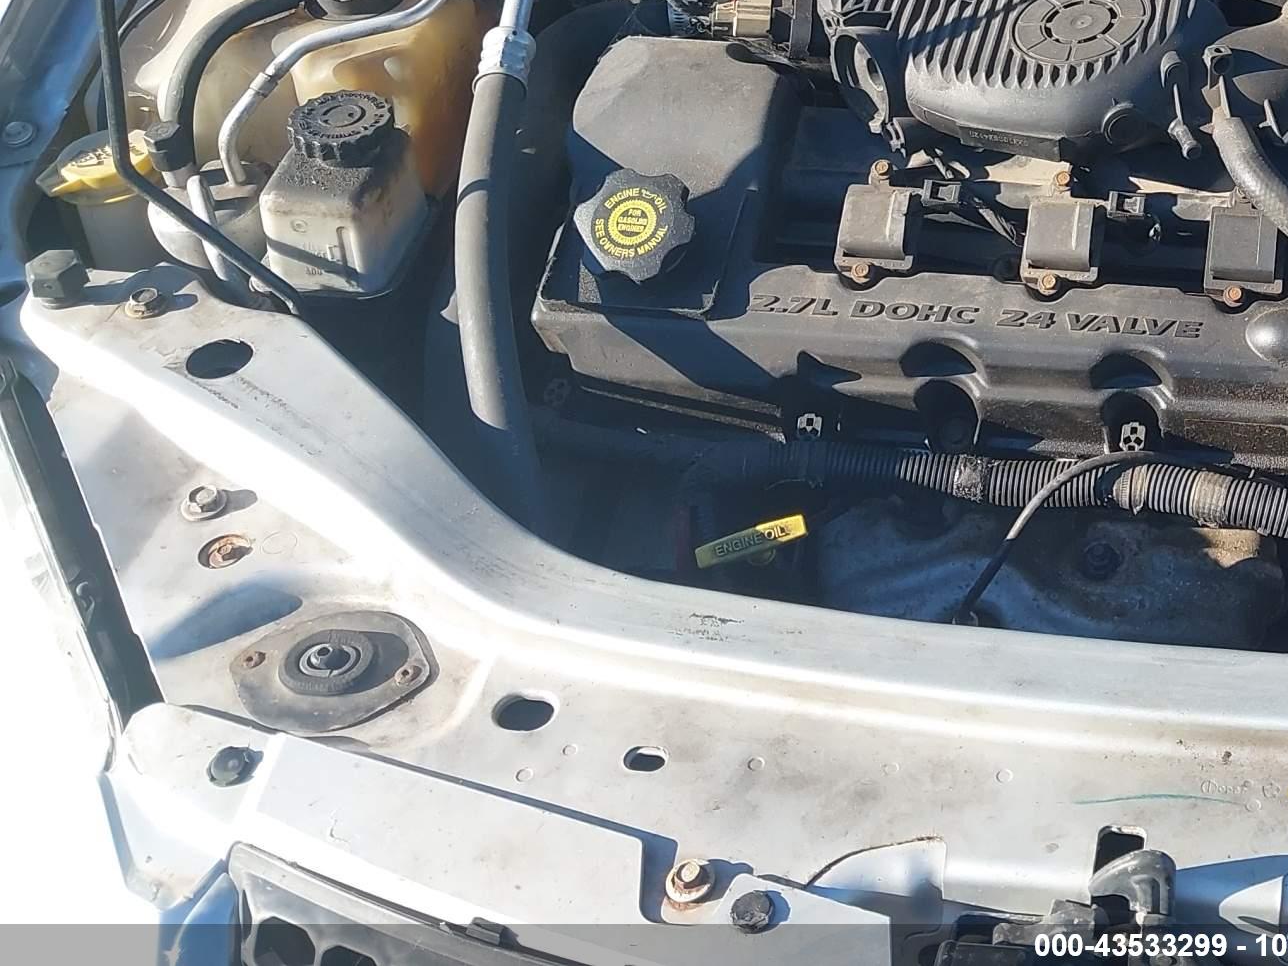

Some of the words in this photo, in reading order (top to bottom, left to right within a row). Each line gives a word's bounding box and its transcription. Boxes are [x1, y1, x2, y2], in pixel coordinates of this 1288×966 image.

[604, 187, 640, 210] ENGINE
[654, 194, 669, 214] OIL
[595, 218, 605, 238] SEE
[636, 225, 668, 255] MANUAL
[747, 294, 839, 318] 2.7L
[849, 300, 980, 325] DOHC
[997, 309, 1057, 329] 24
[1067, 313, 1205, 339] VALVE
[715, 534, 763, 556] ENGINE
[764, 525, 786, 540] OIL
